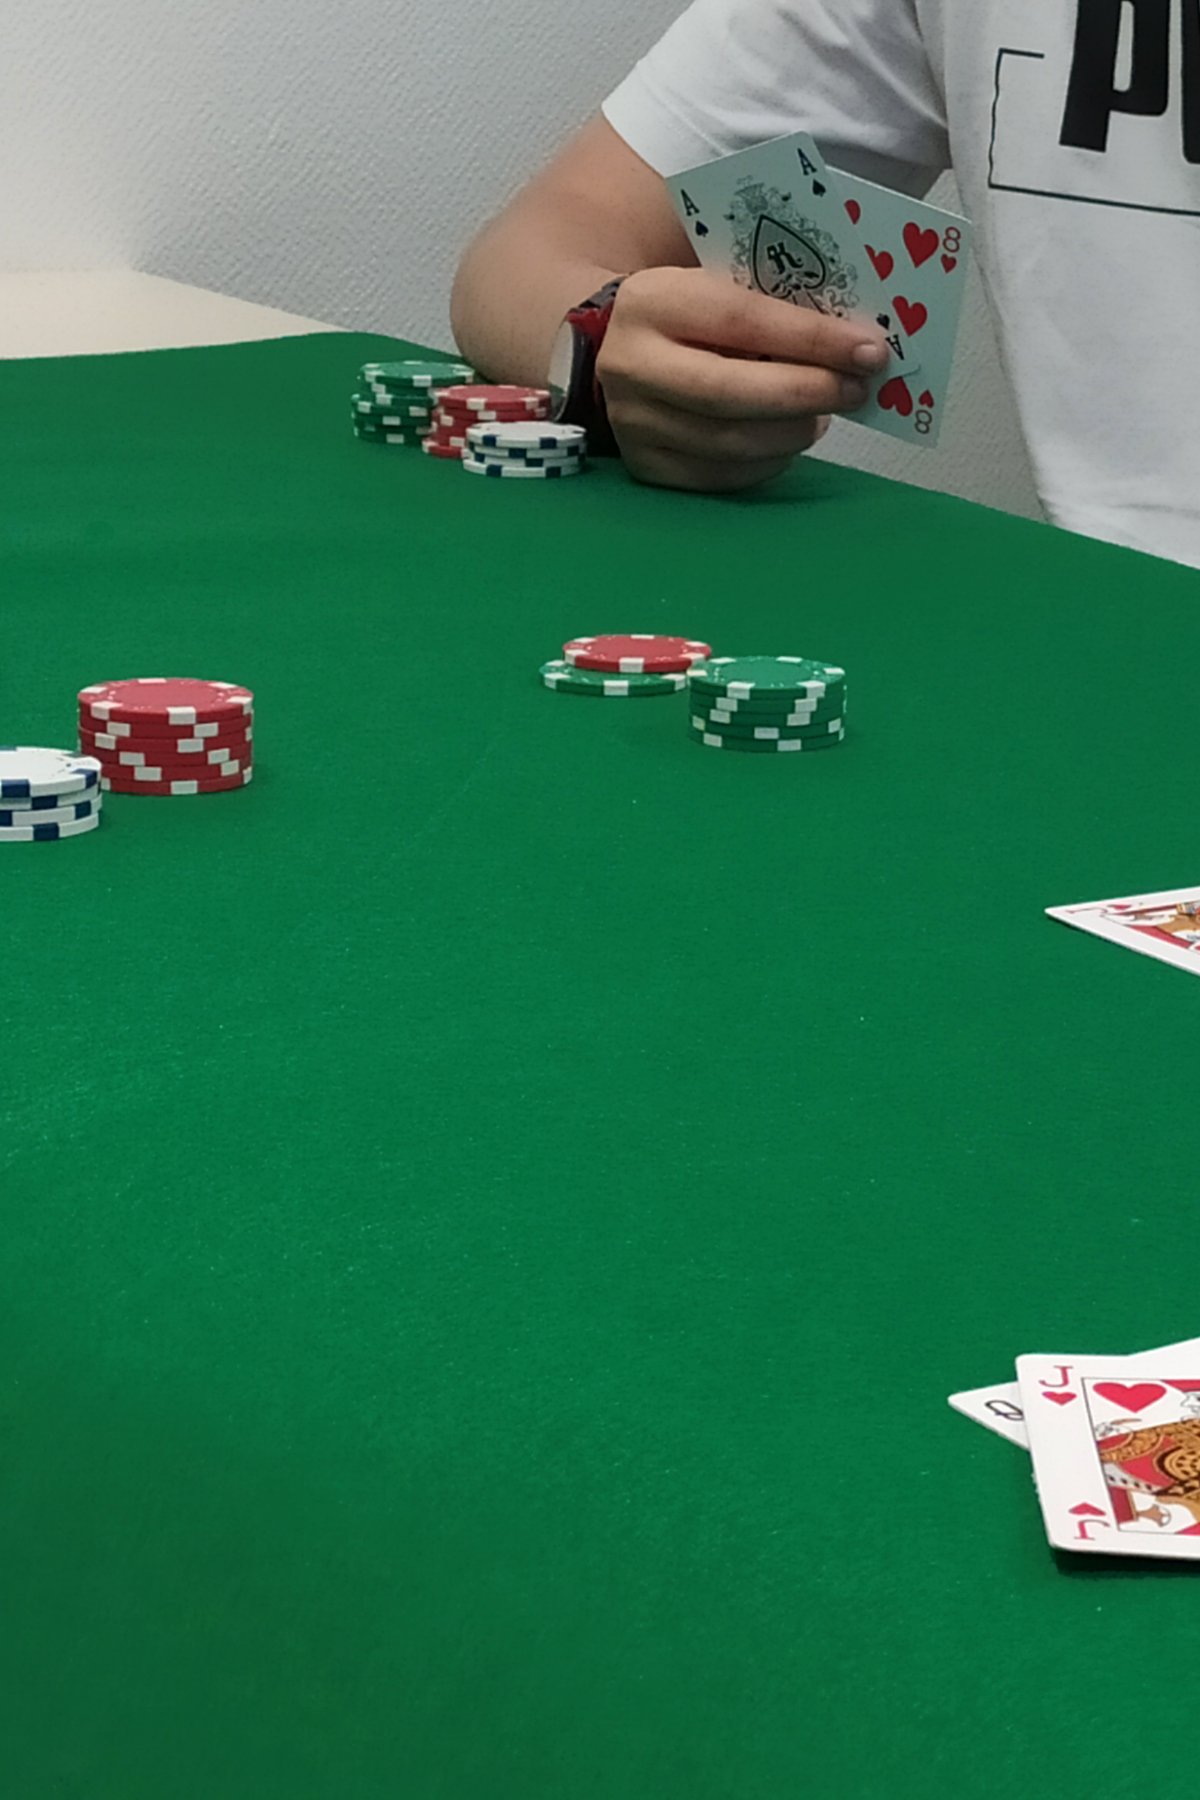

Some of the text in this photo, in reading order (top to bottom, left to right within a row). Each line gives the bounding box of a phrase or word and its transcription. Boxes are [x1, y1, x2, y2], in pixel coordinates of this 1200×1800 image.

[797, 147, 818, 176] A
[681, 188, 700, 217] A
[942, 226, 961, 253] 8
[914, 409, 933, 434] 8
[1038, 1364, 1074, 1388] J
[1072, 1518, 1111, 1541] J
